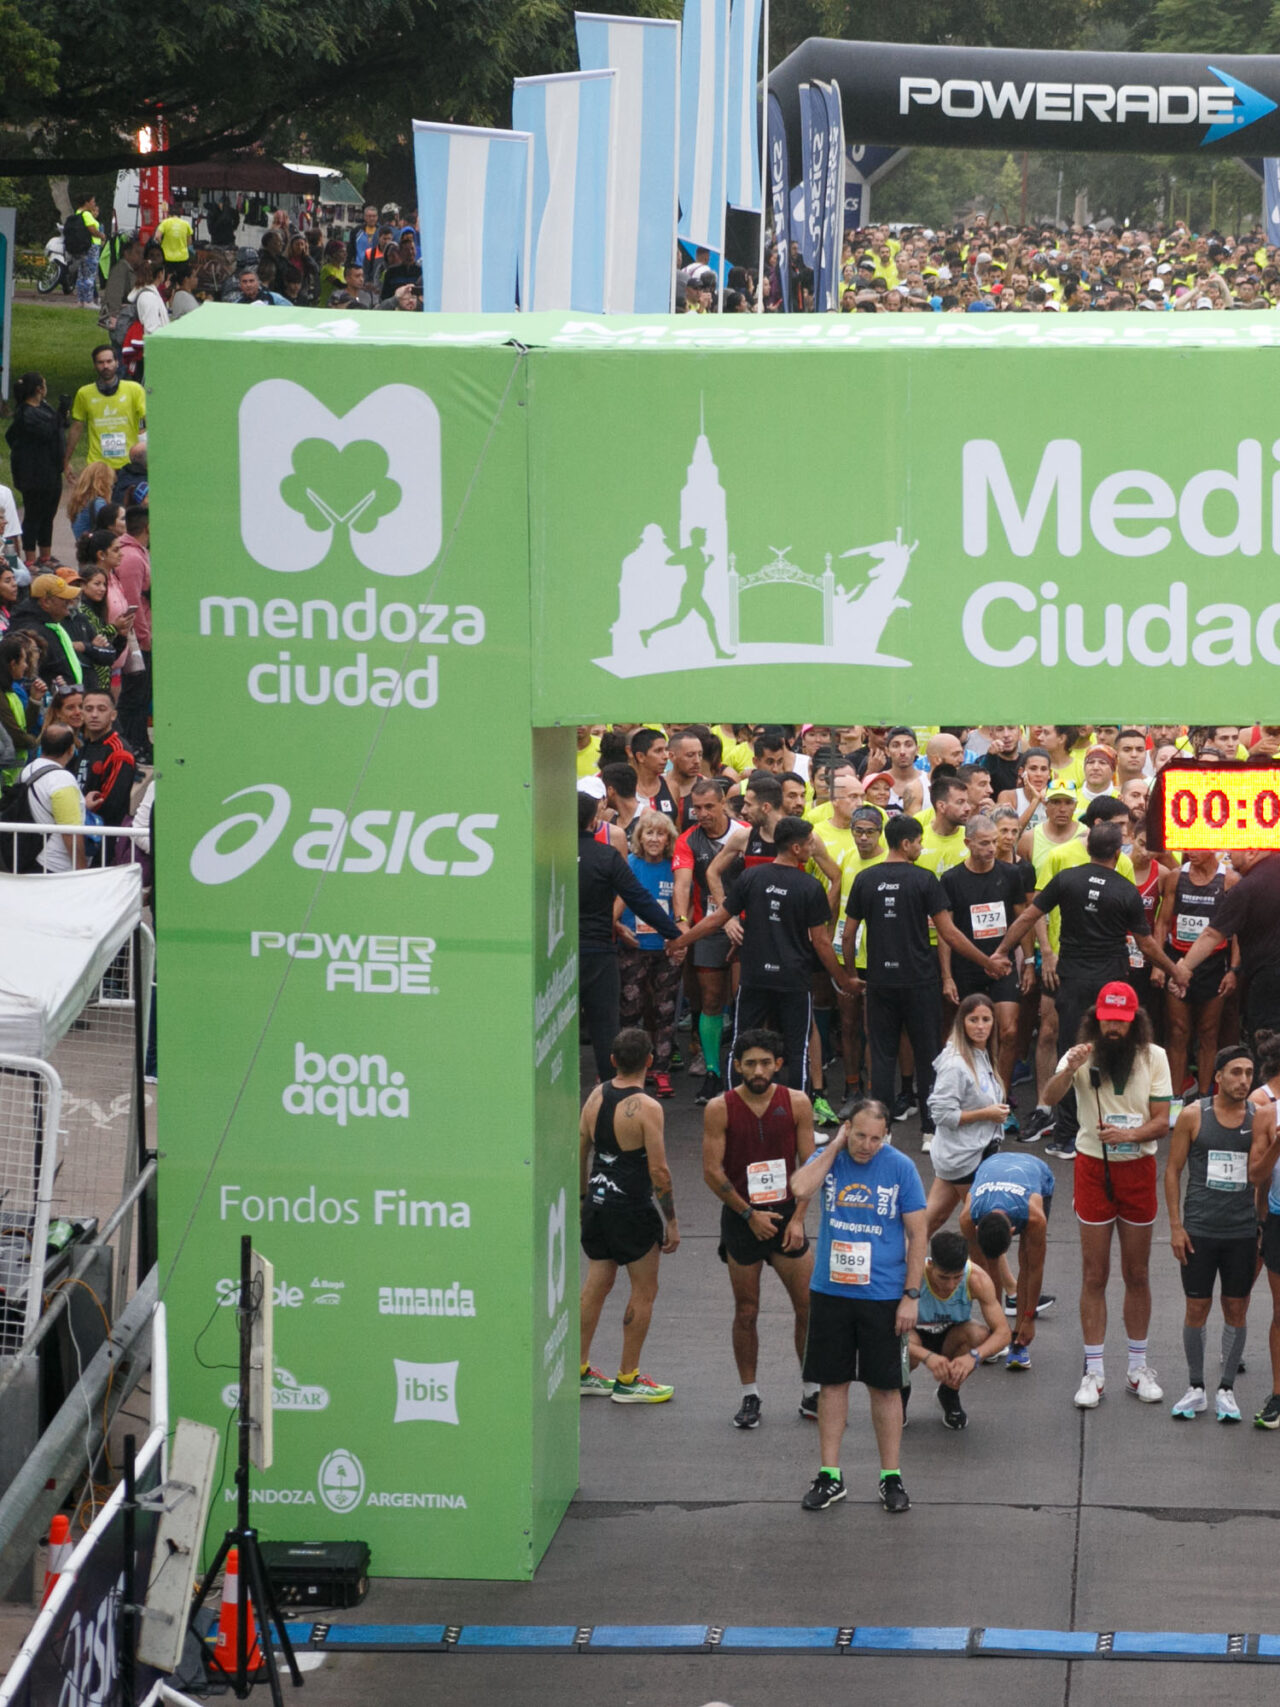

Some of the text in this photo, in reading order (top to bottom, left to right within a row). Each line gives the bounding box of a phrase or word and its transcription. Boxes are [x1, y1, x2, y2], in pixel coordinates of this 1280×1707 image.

[899, 76, 1237, 126] POWERADE
[199, 587, 486, 646] mendoza
[247, 650, 439, 710] ciudad
[292, 807, 499, 877] asics
[976, 911, 1000, 925] 1737
[1181, 917, 1203, 928] 504
[250, 930, 437, 964] POWER
[326, 960, 432, 995] ADE
[281, 1082, 410, 1127] aqua
[760, 1172, 775, 1185] 61
[1222, 1163, 1234, 1174] 11
[219, 1184, 471, 1229] Fondos Fima
[876, 1184, 894, 1217] IRIS
[834, 1253, 865, 1267] 1889
[378, 1281, 477, 1317] amanda
[404, 1377, 449, 1403] ibis
[224, 1488, 468, 1510] MNDOZA ARGENTINA
